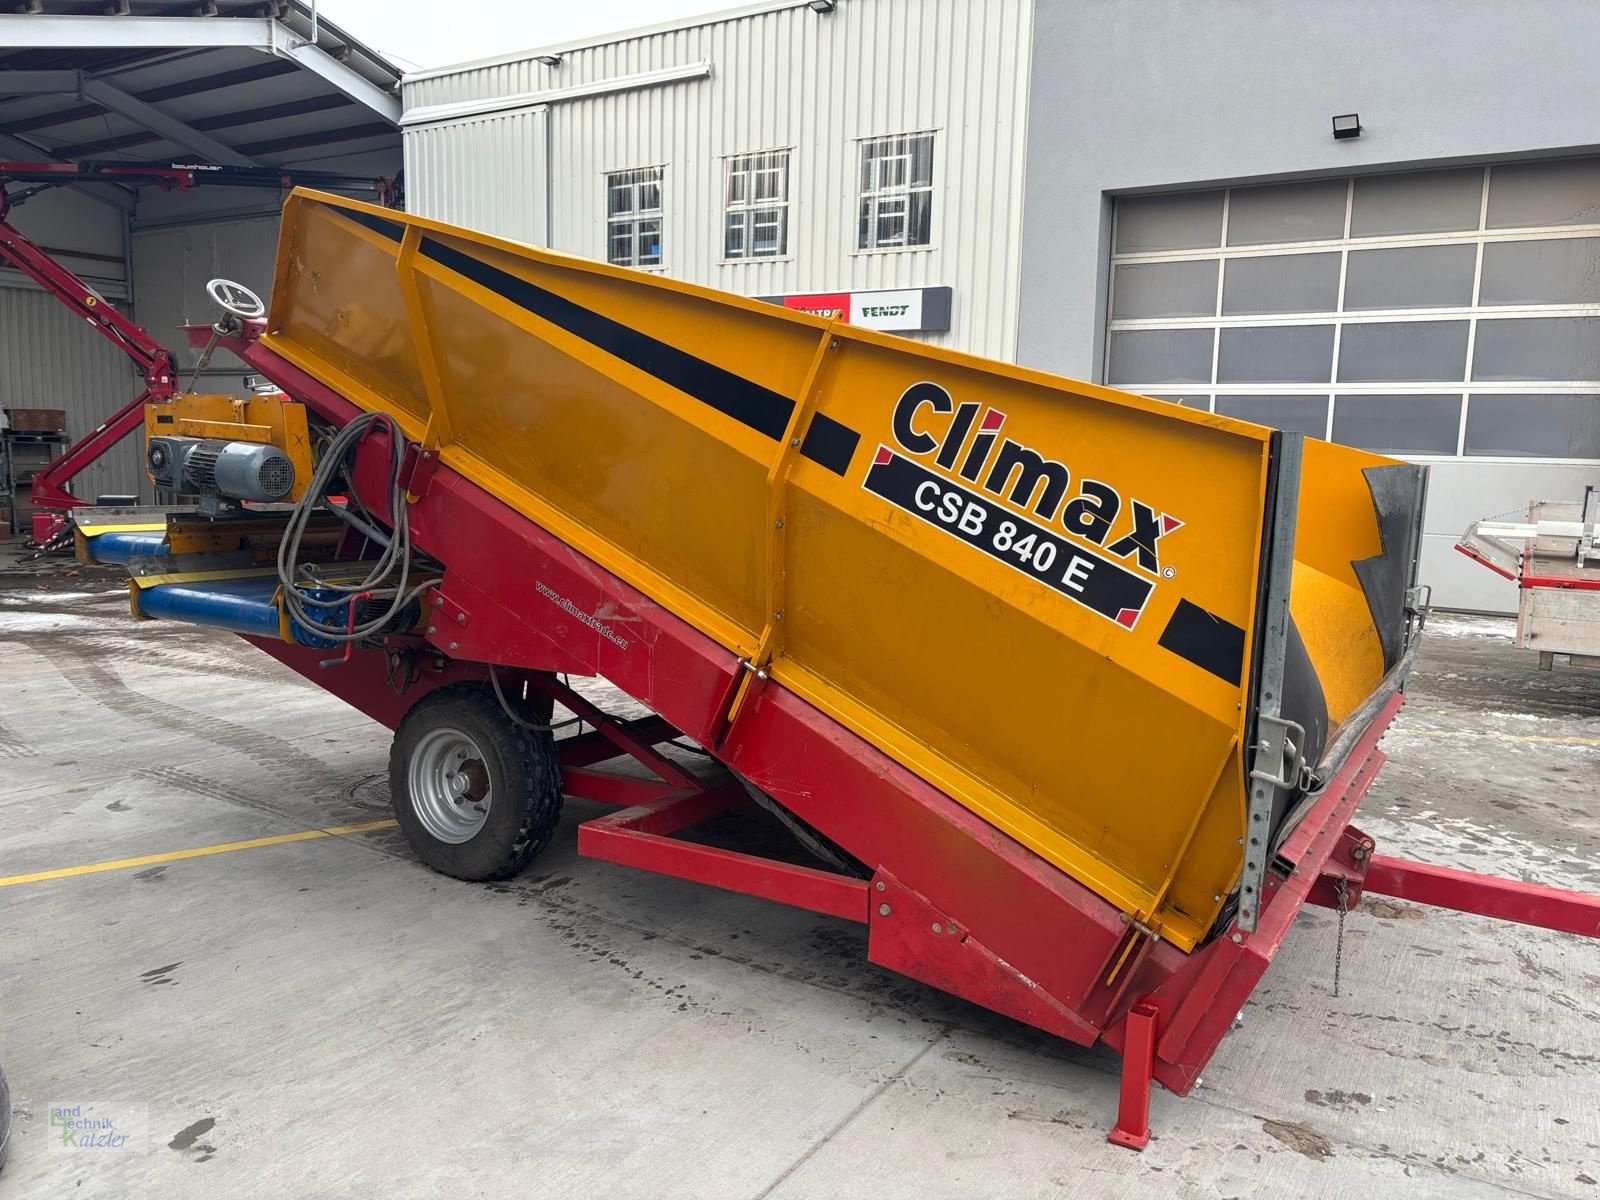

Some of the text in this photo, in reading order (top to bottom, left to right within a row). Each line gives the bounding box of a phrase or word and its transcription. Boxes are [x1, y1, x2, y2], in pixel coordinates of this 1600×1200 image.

[862, 305, 909, 317] FENDT
[892, 381, 1185, 576] Climax
[914, 481, 1095, 592] CSB 840 E
[535, 581, 628, 650] www.climaxtrade.eu
